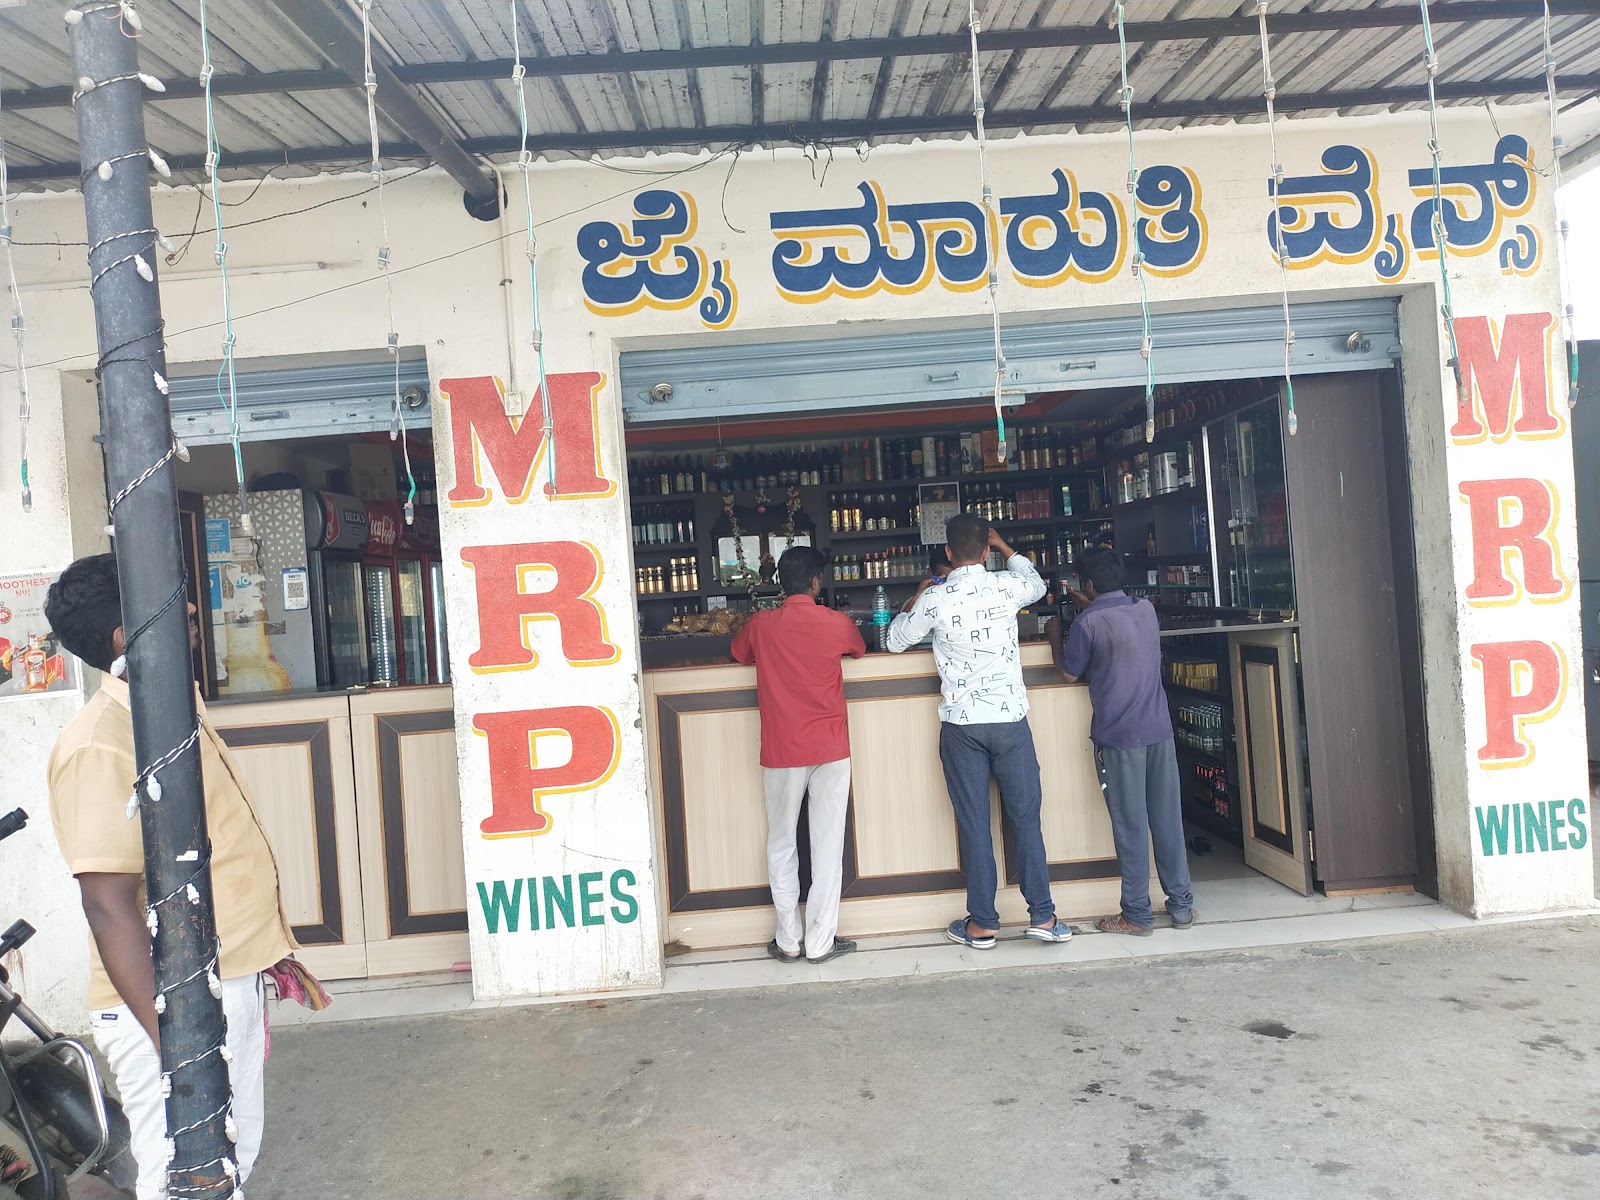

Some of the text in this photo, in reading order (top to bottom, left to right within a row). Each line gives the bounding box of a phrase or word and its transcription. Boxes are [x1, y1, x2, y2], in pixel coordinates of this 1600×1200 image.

[577, 190, 738, 331] ಜೈ
[769, 164, 1210, 303] ಮಾರುತಿ
[1474, 797, 1588, 857] WINES
[475, 868, 638, 935] WINES
